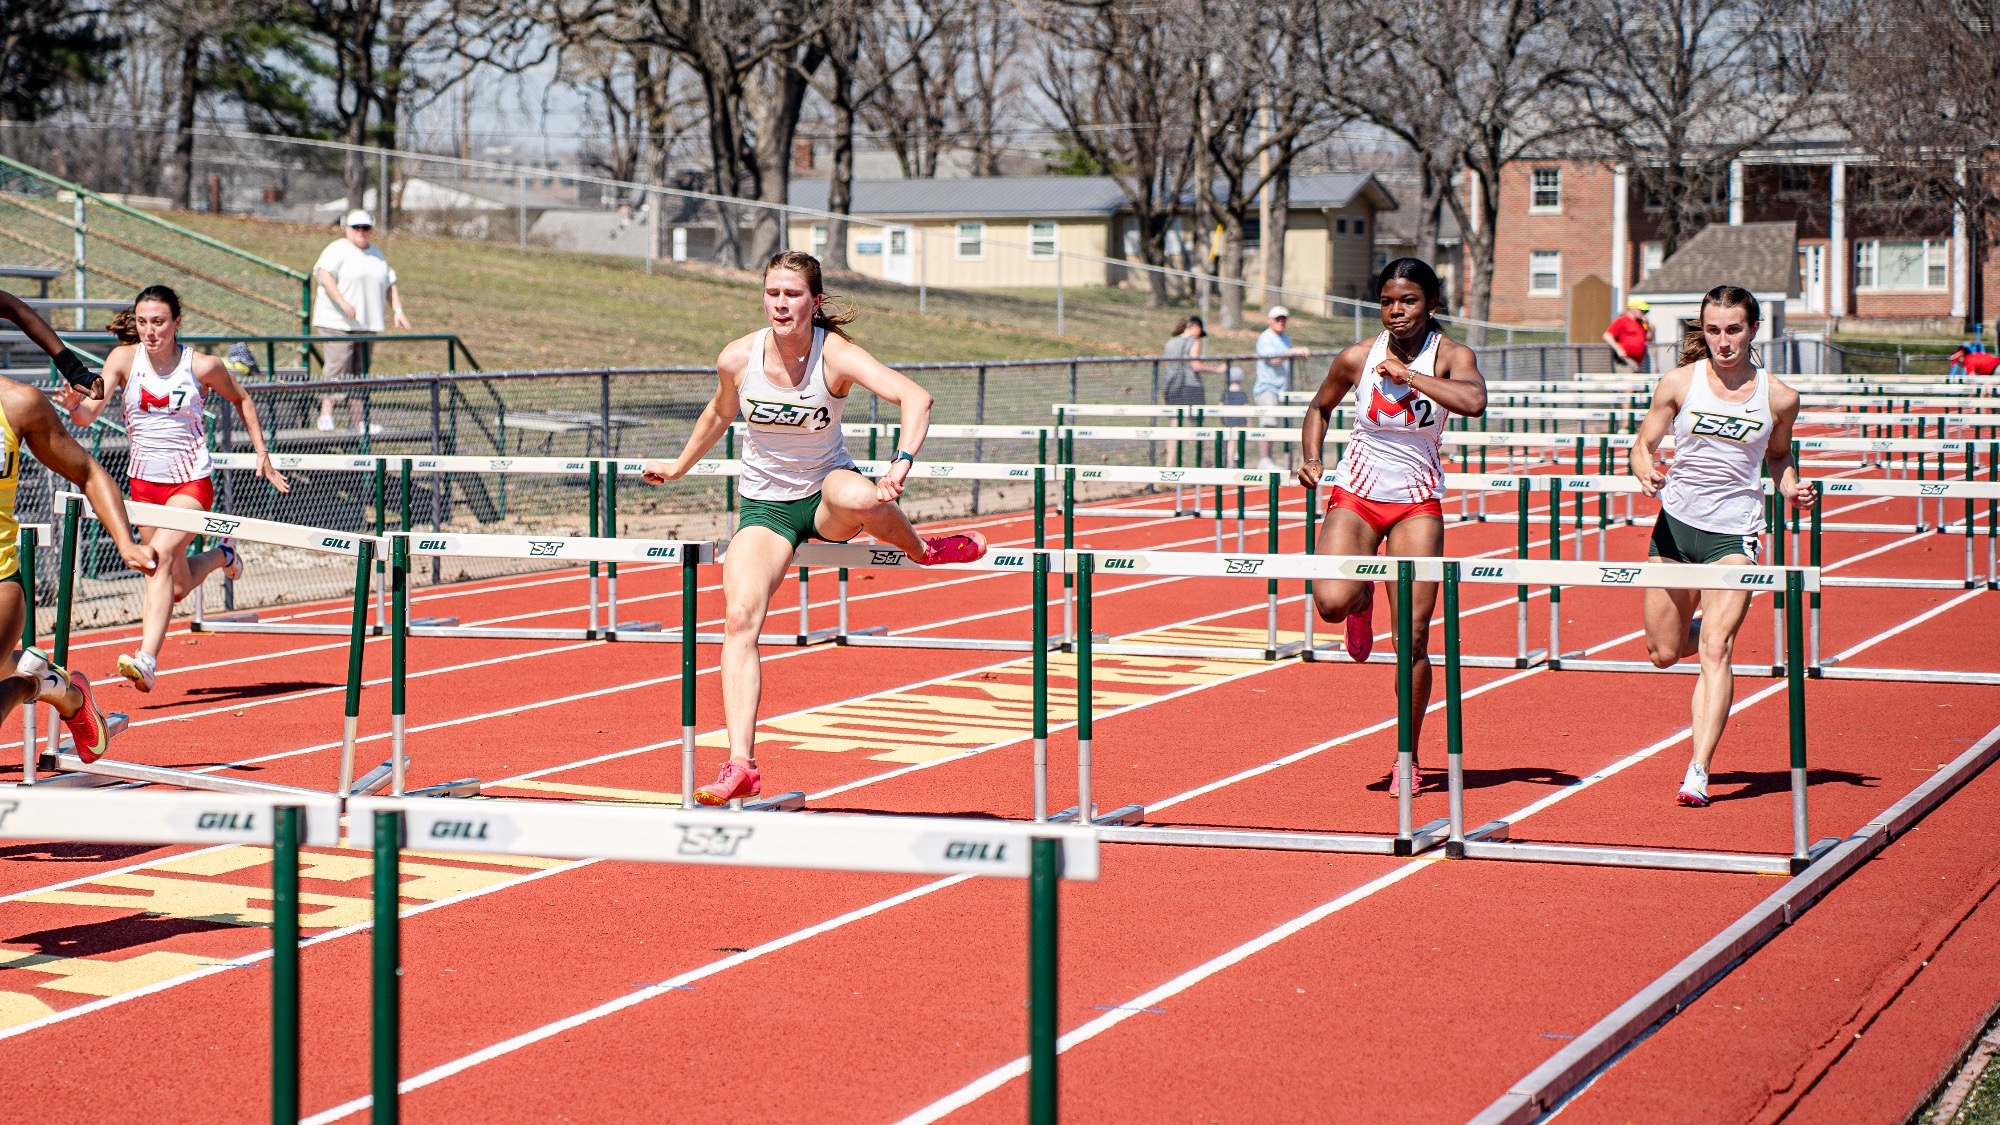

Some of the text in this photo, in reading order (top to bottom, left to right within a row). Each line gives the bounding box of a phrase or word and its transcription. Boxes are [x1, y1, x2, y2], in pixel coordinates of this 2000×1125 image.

[172, 390, 186, 411] 7
[1366, 384, 1420, 426] M
[746, 399, 815, 427] S&T
[813, 407, 831, 430] 3
[1415, 400, 1435, 428] 2
[1690, 411, 1764, 442] S&T
[1920, 484, 1949, 495] S&T
[203, 516, 351, 550] S&T GILL
[419, 540, 676, 557] GILL S&T GILL
[869, 550, 1025, 566] S&T GILL
[1104, 558, 1388, 575] GILL S&T GILL
[1471, 566, 1774, 585] GILL S&T GILL
[197, 810, 256, 833] GILL
[429, 819, 1009, 865] GILL S&T GILL
